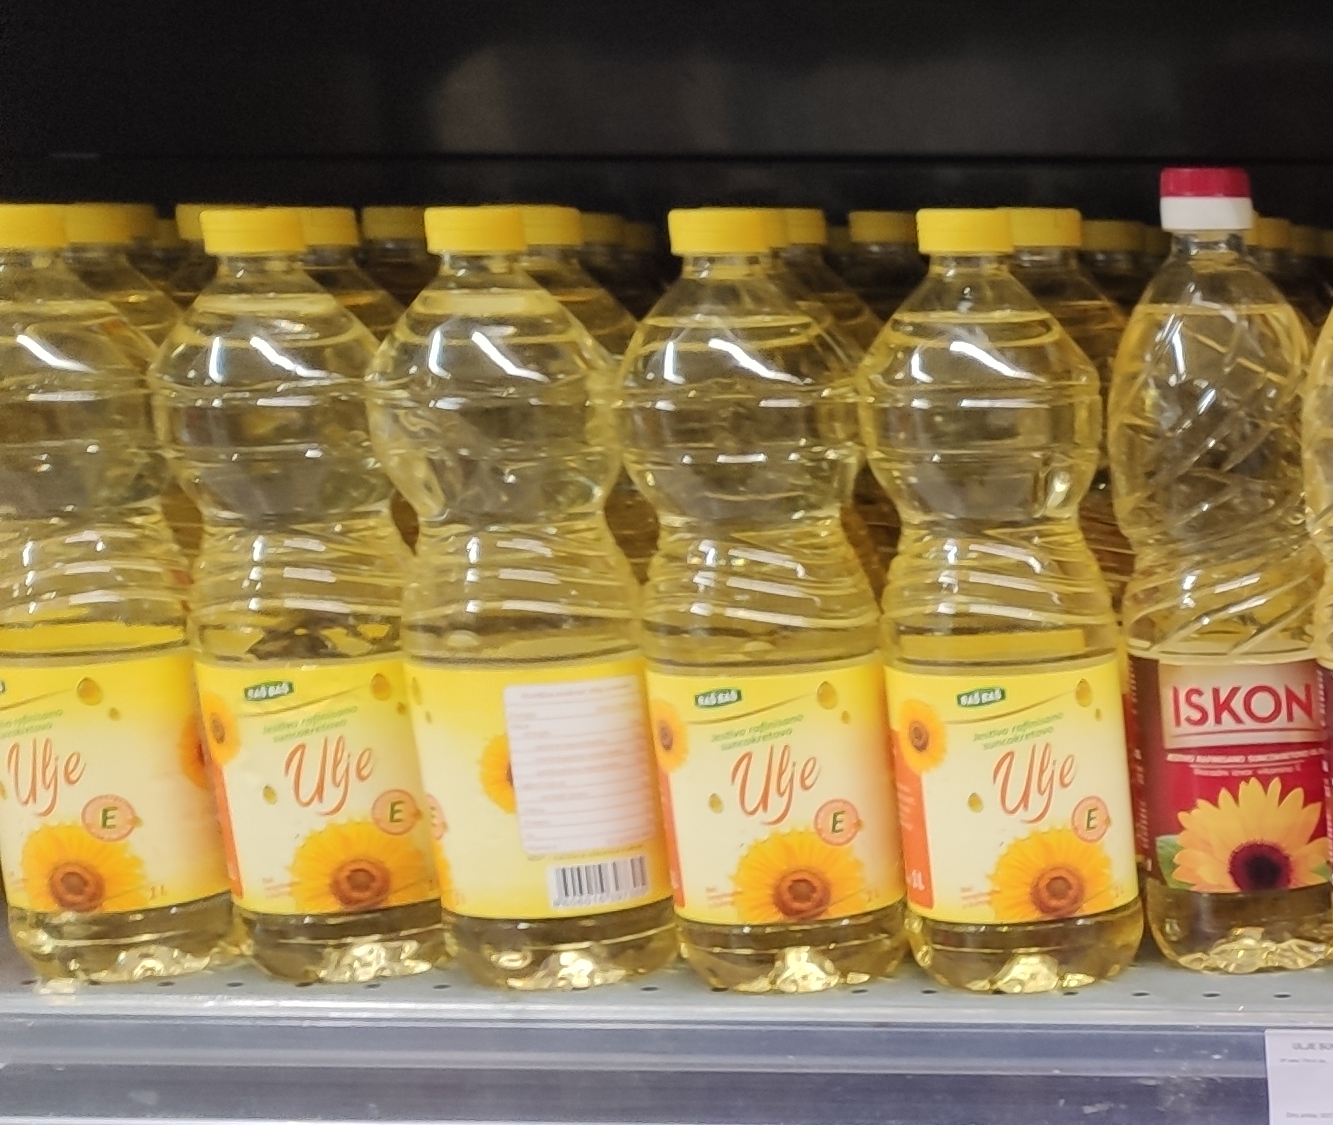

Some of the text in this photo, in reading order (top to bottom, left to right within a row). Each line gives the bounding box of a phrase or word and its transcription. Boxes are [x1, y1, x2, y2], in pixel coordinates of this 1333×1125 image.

[1172, 683, 1314, 728] ISKON
[7, 737, 87, 817] Ulje
[284, 734, 374, 817] Ulje
[731, 744, 821, 827] Ulje
[992, 742, 1077, 825] Ulje
[101, 806, 118, 830] E
[389, 800, 404, 823] E
[831, 810, 845, 834] E
[1086, 807, 1098, 832] E
